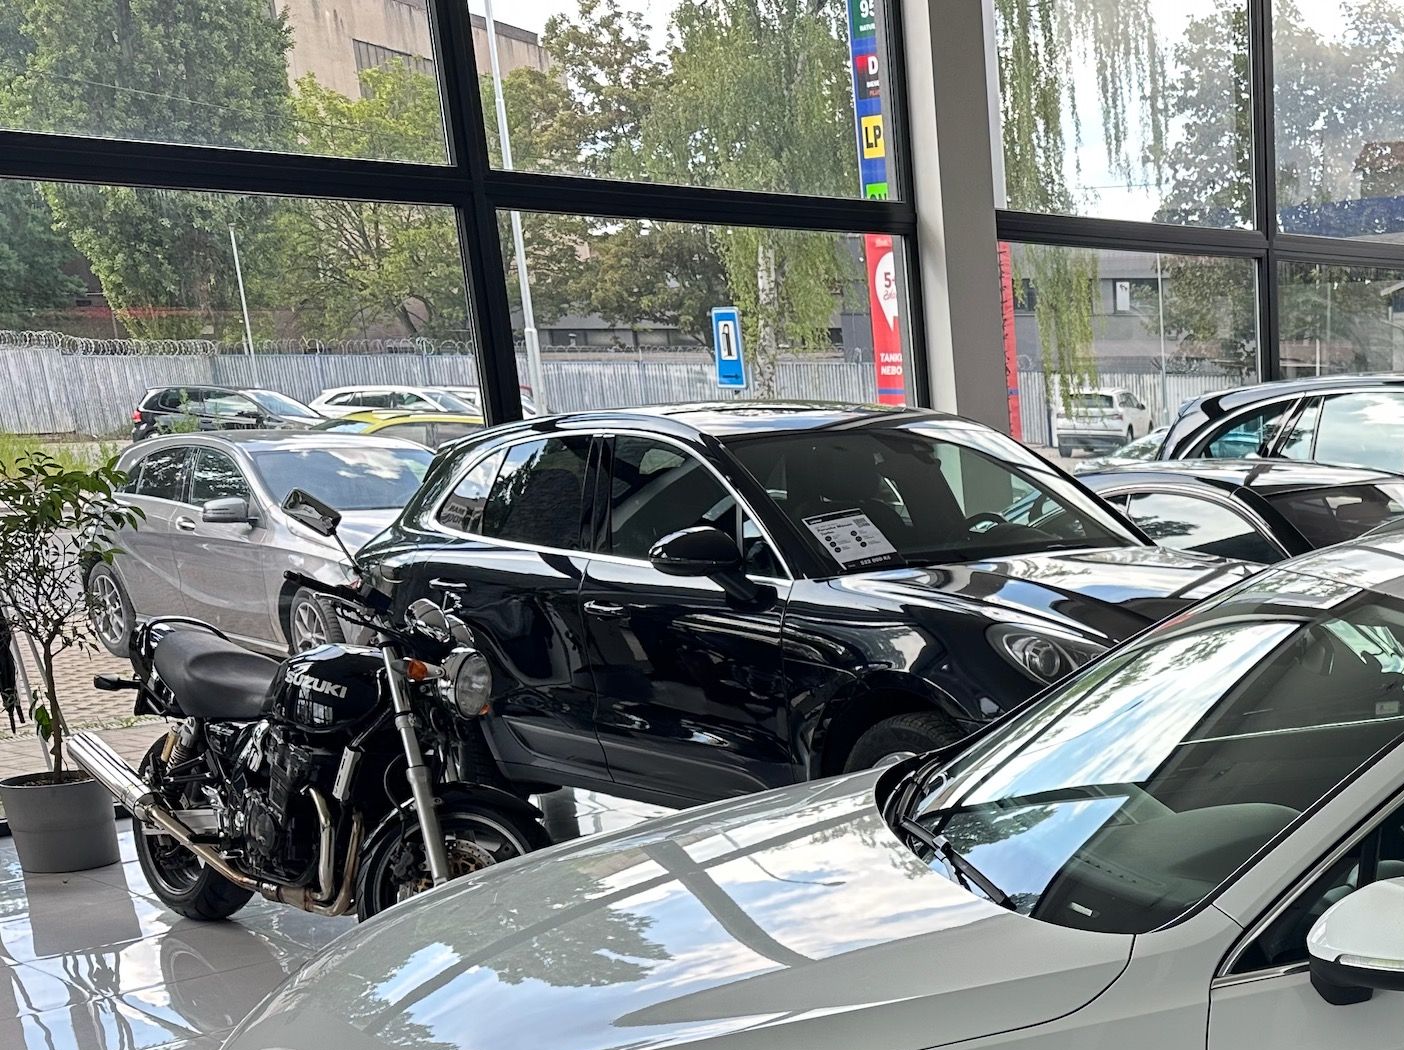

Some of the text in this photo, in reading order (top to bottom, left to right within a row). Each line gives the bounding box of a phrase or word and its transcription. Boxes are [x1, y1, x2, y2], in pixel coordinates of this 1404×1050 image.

[867, 56, 878, 75] D
[880, 365, 903, 376] NEBO
[284, 670, 348, 699] SUZUKI
